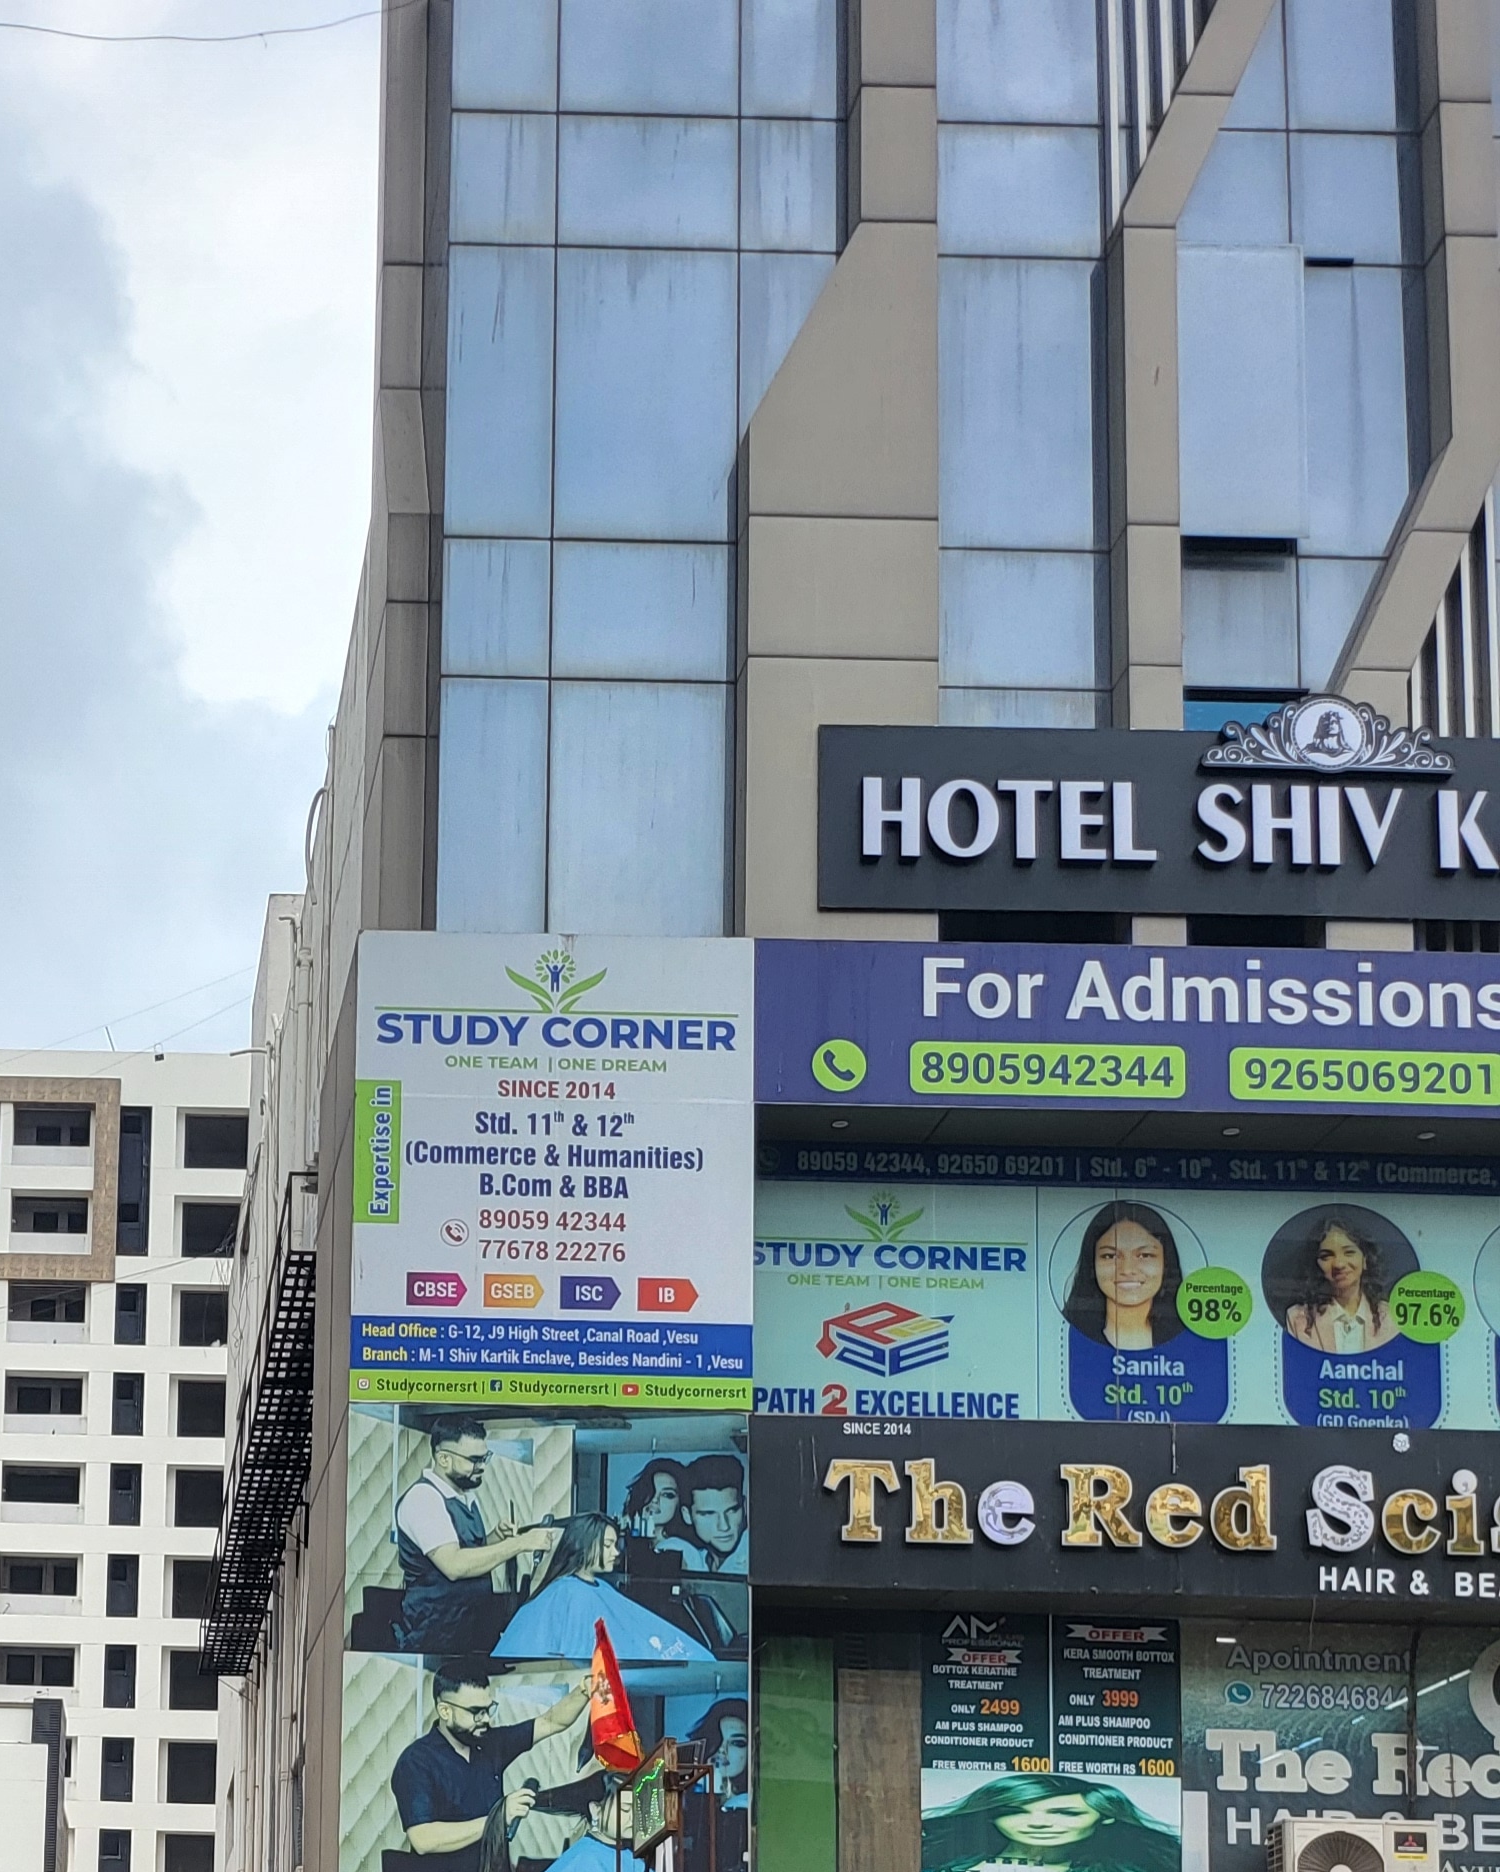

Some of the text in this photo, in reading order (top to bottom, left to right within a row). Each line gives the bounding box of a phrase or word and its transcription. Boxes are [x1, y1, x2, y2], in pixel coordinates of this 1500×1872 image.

[860, 776, 1158, 863] HOTEL
[1197, 783, 1403, 868] SHIV
[922, 957, 1500, 1030] For Admissions
[376, 1013, 736, 1051] STUDY CORNER
[445, 1055, 667, 1073] ONE TEAM ONE DREAM
[922, 1053, 1492, 1095] 8905942344 9265069201
[498, 1079, 616, 1100] SINCE 2014
[475, 1111, 635, 1138] Std. 11th 12th
[369, 1086, 394, 1216] Expertise in
[405, 1140, 704, 1172] (Commerce Humanities)
[798, 1151, 858, 1171] 89059
[863, 1152, 931, 1175] 42344,
[937, 1154, 998, 1175] 92650
[1005, 1155, 1064, 1176] 69201
[1090, 1158, 1128, 1178] Std.
[1229, 1160, 1266, 1181] Std.
[1377, 1161, 1498, 1187] (Commerce,
[479, 1173, 629, 1199] B.Com BBA
[479, 1210, 627, 1232] 89059 42344
[479, 1240, 626, 1263] 77678 22276
[753, 1241, 1027, 1272] STUDY CORNER
[413, 1281, 457, 1299] CBSE
[490, 1283, 535, 1300] GSEB
[787, 1274, 984, 1290] ONE TEAM ONE DREAM
[1186, 1282, 1243, 1297] Percentage
[575, 1284, 603, 1302] ISC
[658, 1286, 675, 1303] IB
[1397, 1287, 1456, 1301] Percentage
[1187, 1299, 1242, 1323] 98%
[1395, 1303, 1460, 1328] 97.6%
[362, 1323, 395, 1338] Head
[398, 1324, 437, 1338] Office
[448, 1325, 485, 1341] G-12,
[488, 1325, 505, 1340] J9
[508, 1326, 538, 1344] High
[542, 1327, 579, 1342] Street
[626, 1329, 659, 1344] Road
[362, 1347, 408, 1362] Branch
[418, 1349, 446, 1363] M-1
[449, 1349, 477, 1364] Shiv
[481, 1350, 520, 1365] Kartik
[523, 1351, 575, 1367] Enclave,
[578, 1352, 629, 1367] Besides
[632, 1353, 682, 1368] Nandini
[1112, 1355, 1185, 1377] Sanika
[1319, 1359, 1403, 1382] Aanchal
[376, 1378, 747, 1402] Studycornersrt Studycornersrt Studycornersrt
[1104, 1384, 1148, 1405] Std.
[1318, 1388, 1360, 1409] Std.
[753, 1384, 1020, 1419] PATH 2 EXCELLENCE
[843, 1422, 911, 1436] SINCE 2014
[823, 1457, 1037, 1546] The
[1059, 1464, 1278, 1553] Red
[1319, 1566, 1396, 1595] HAIR
[1410, 1570, 1430, 1595] &
[1089, 1629, 1145, 1641] OFFER
[962, 1653, 1007, 1665] OFFER
[1063, 1648, 1175, 1663] KERA SMOOTH BOTTOX
[933, 1665, 1018, 1677] BOTTOX KERATINE
[1083, 1667, 1142, 1681] TREATMENT
[948, 1680, 1004, 1691] TREATMENT
[951, 1699, 1020, 1715] ONLY 2499
[1069, 1690, 1139, 1708] ONLY 3999
[951, 1722, 1024, 1733] PLUS SHAMPOO
[1075, 1716, 1151, 1729] PLUS SHAMPOO
[924, 1736, 1034, 1748] CONDITIONER PRODUCT
[1058, 1734, 1173, 1750] CONDITIONER PRODUCT
[933, 1756, 1050, 1773] FREE WORTH 1600
[1058, 1759, 1175, 1776] FREE WORTH 1600
[1205, 1729, 1352, 1795] The
